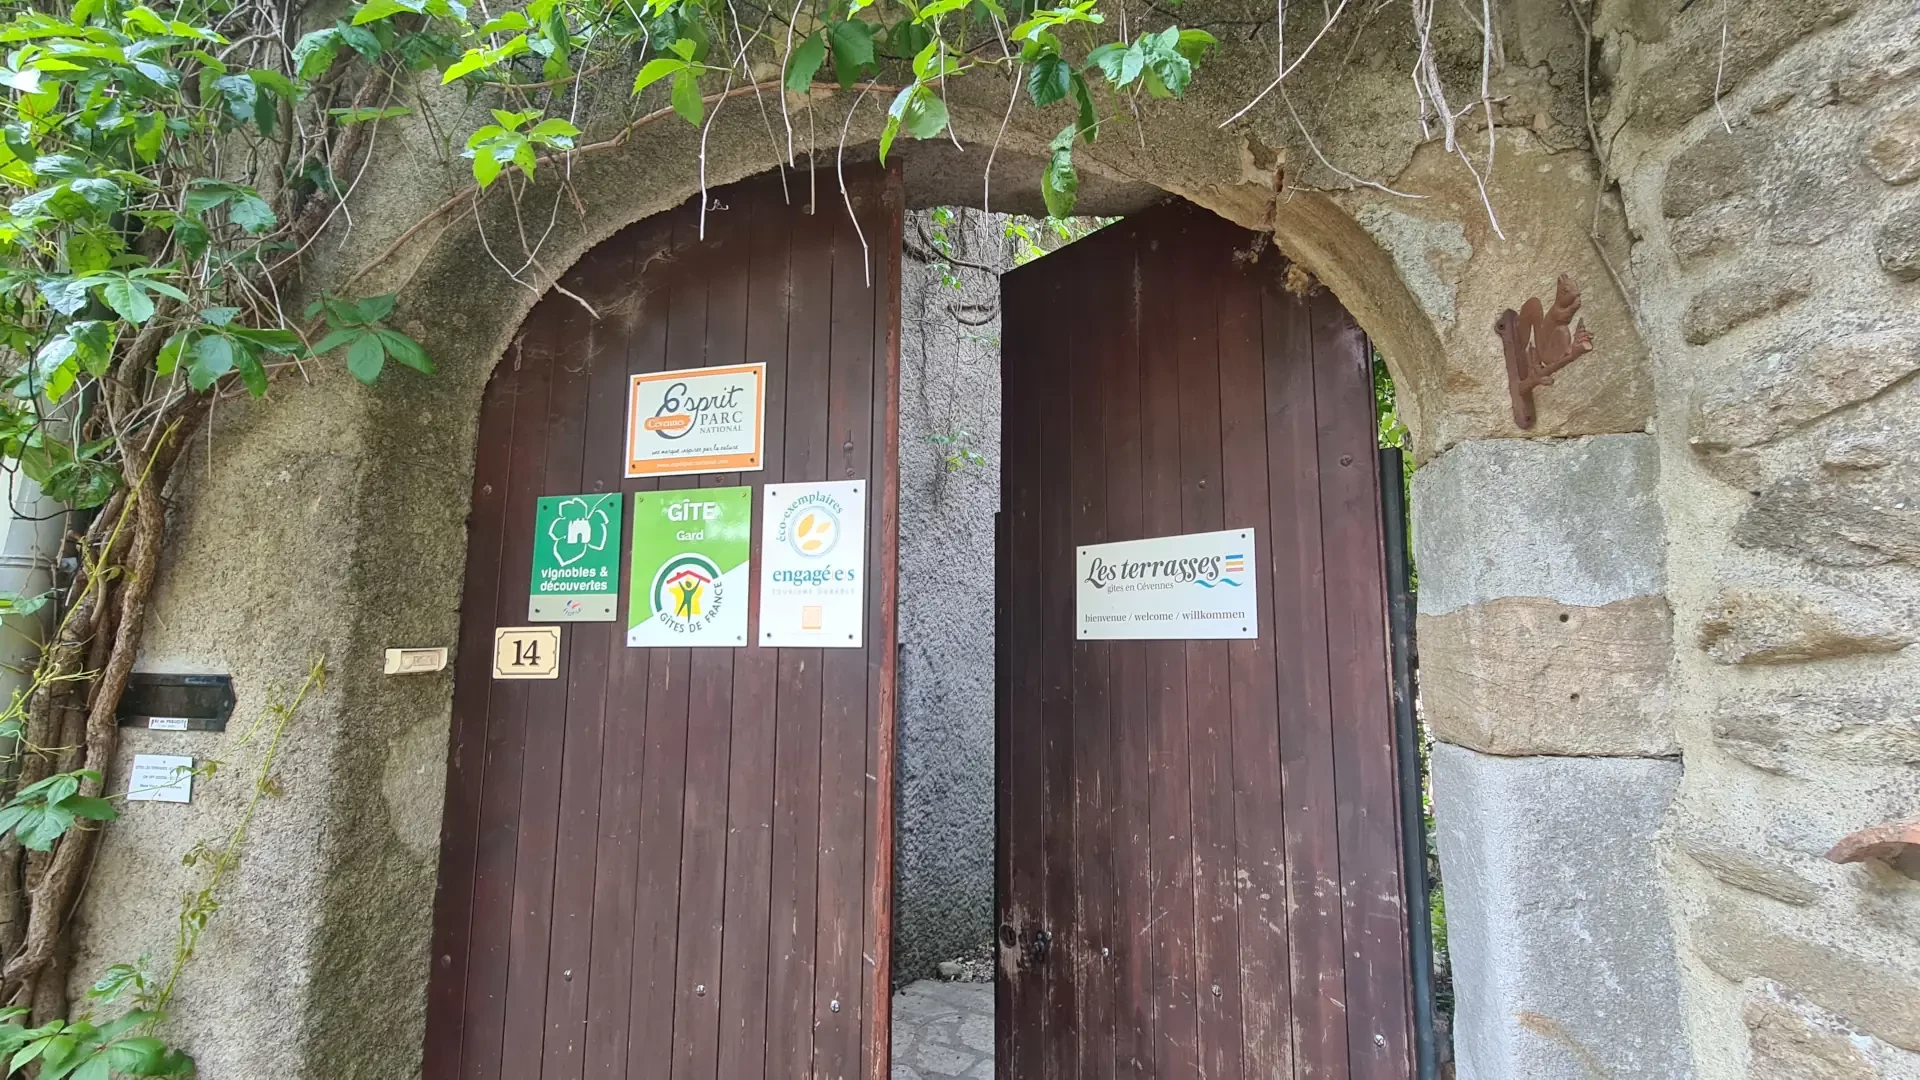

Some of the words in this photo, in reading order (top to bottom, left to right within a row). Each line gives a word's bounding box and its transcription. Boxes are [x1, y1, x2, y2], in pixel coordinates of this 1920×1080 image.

[700, 410, 743, 426] PARC
[700, 425, 743, 434] NATIONAL
[667, 498, 717, 521] GÎTE
[776, 491, 843, 542] éco-exemplaires
[676, 530, 704, 541] Gard
[541, 566, 596, 580] vignobles
[599, 566, 608, 577] &
[1084, 557, 1118, 588] Les
[1120, 554, 1221, 583] terrasses
[540, 579, 608, 591] découvertes
[1136, 581, 1174, 591] Cévennes
[660, 612, 685, 633] GÎTES
[689, 621, 702, 633] DE
[704, 581, 723, 623] FRANCE
[1085, 613, 1127, 623] bienvenue
[1134, 611, 1174, 621] welcome
[1182, 609, 1245, 620] willkommen
[511, 639, 541, 667] 14
